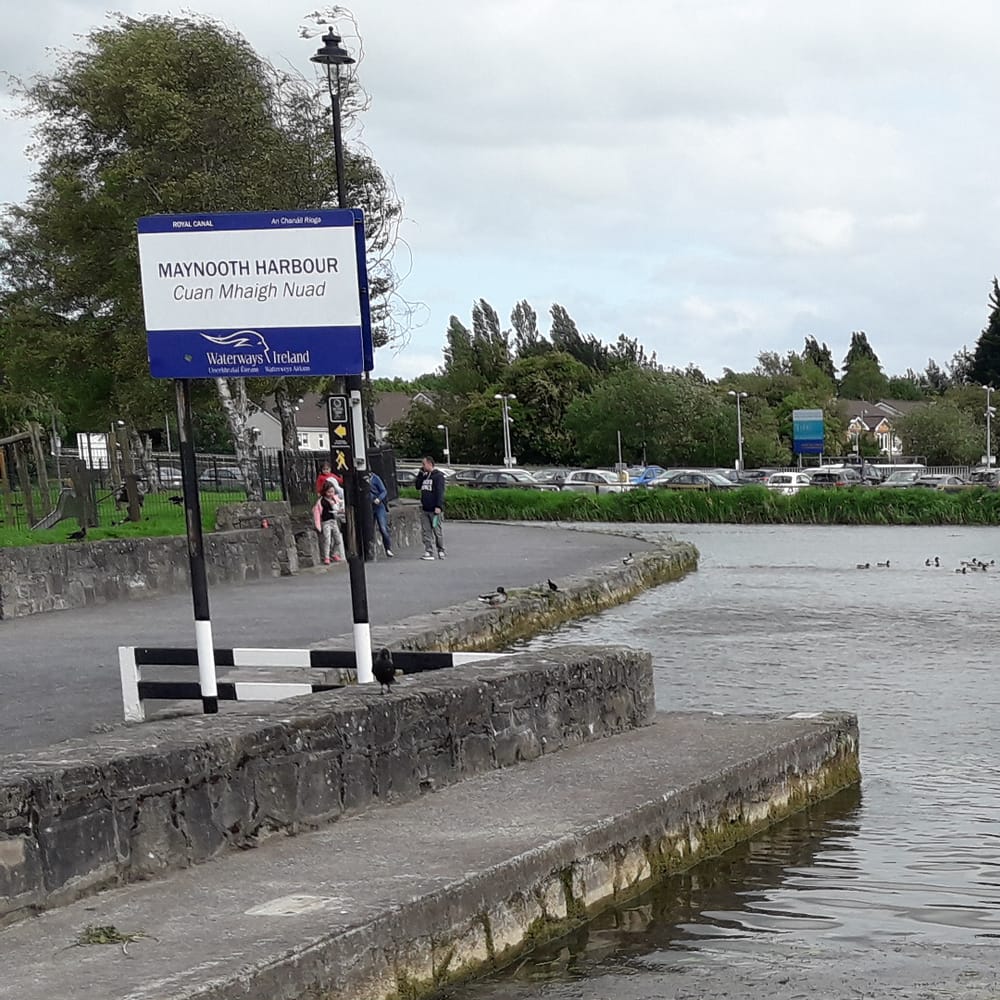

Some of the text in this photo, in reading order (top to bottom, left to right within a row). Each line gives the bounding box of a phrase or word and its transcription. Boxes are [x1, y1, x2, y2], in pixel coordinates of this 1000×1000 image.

[271, 217, 280, 225] An
[158, 257, 339, 278] MAYNOOTH HARBOUR
[173, 280, 326, 302] Cuan Mhaigh Nuad
[206, 350, 310, 366] Waterways Ireland
